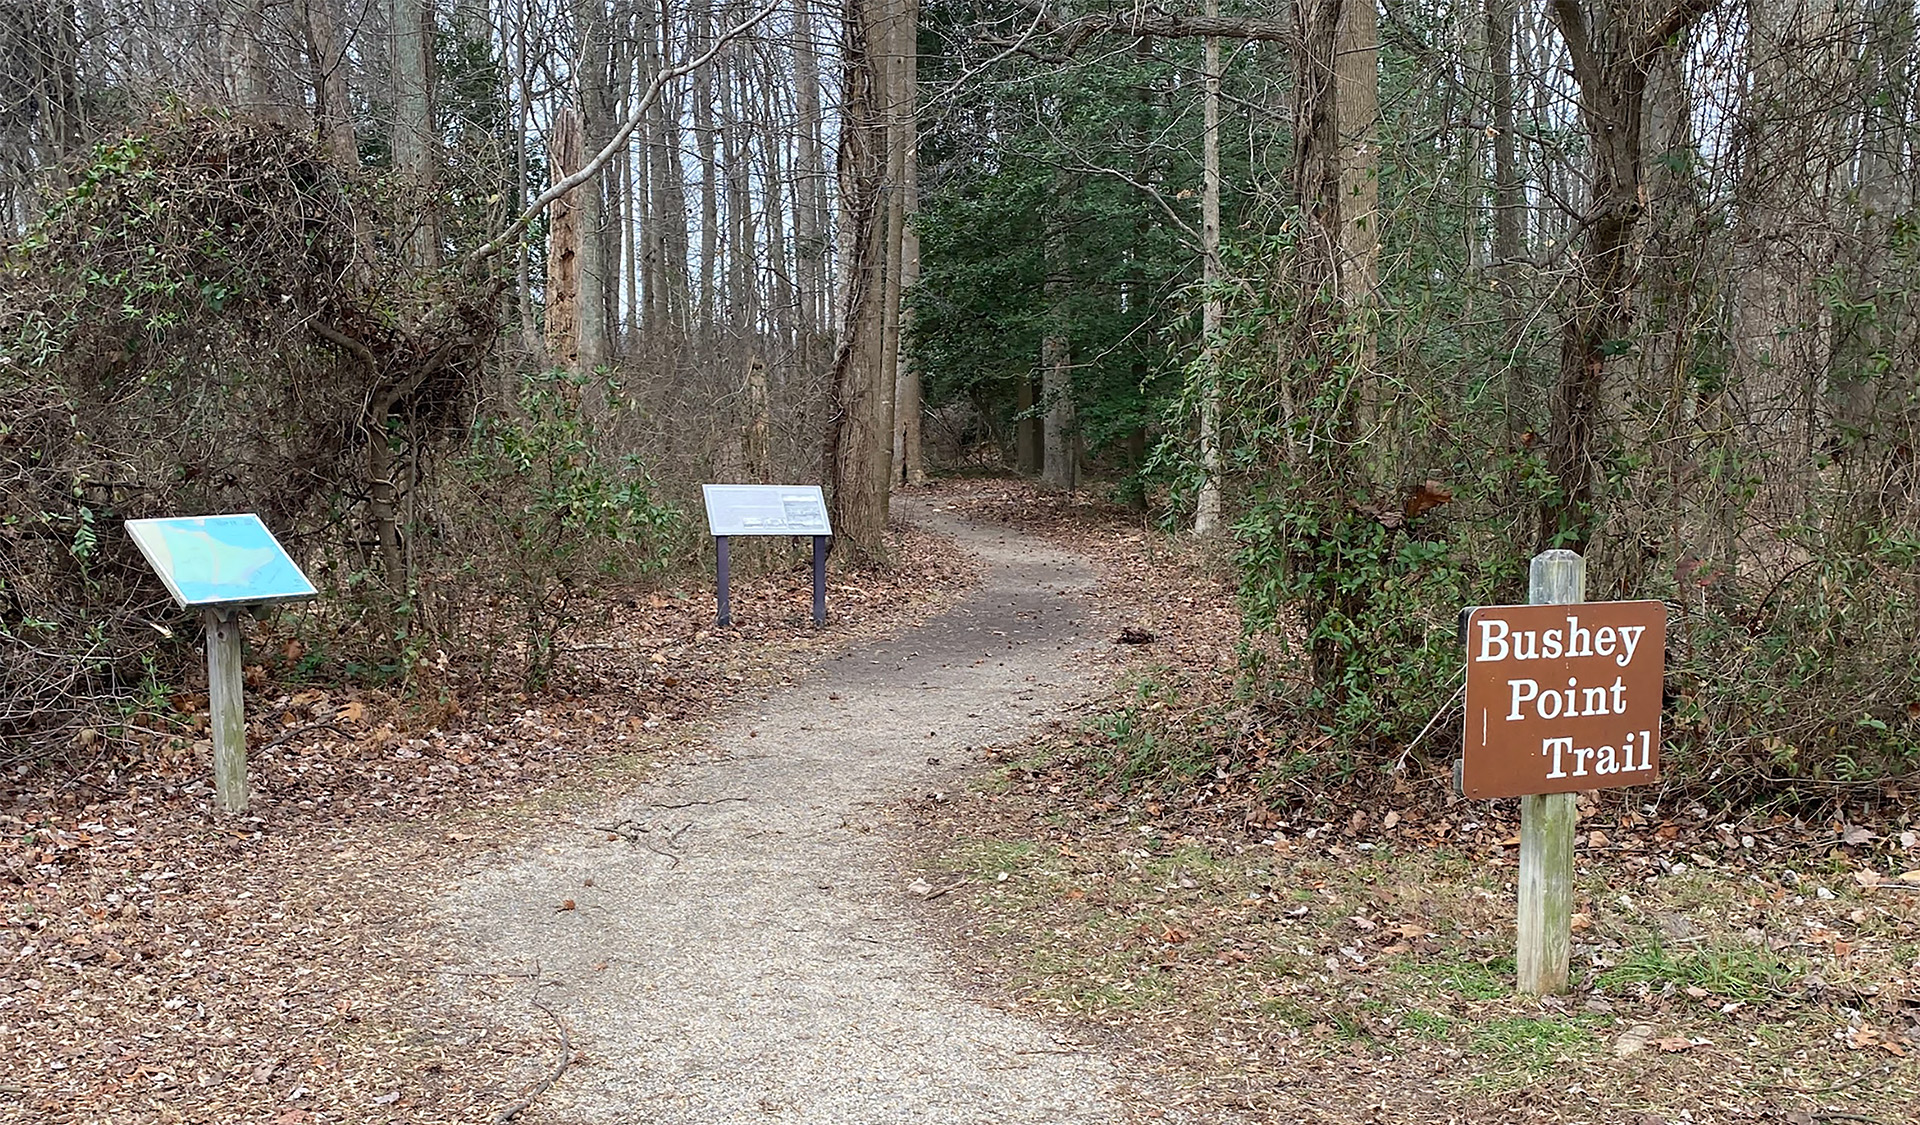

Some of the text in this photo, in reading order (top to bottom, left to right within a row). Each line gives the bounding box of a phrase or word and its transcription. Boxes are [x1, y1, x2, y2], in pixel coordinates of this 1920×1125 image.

[1476, 616, 1646, 667] Bushey
[1506, 675, 1627, 721] Point
[1542, 730, 1653, 779] Trail
